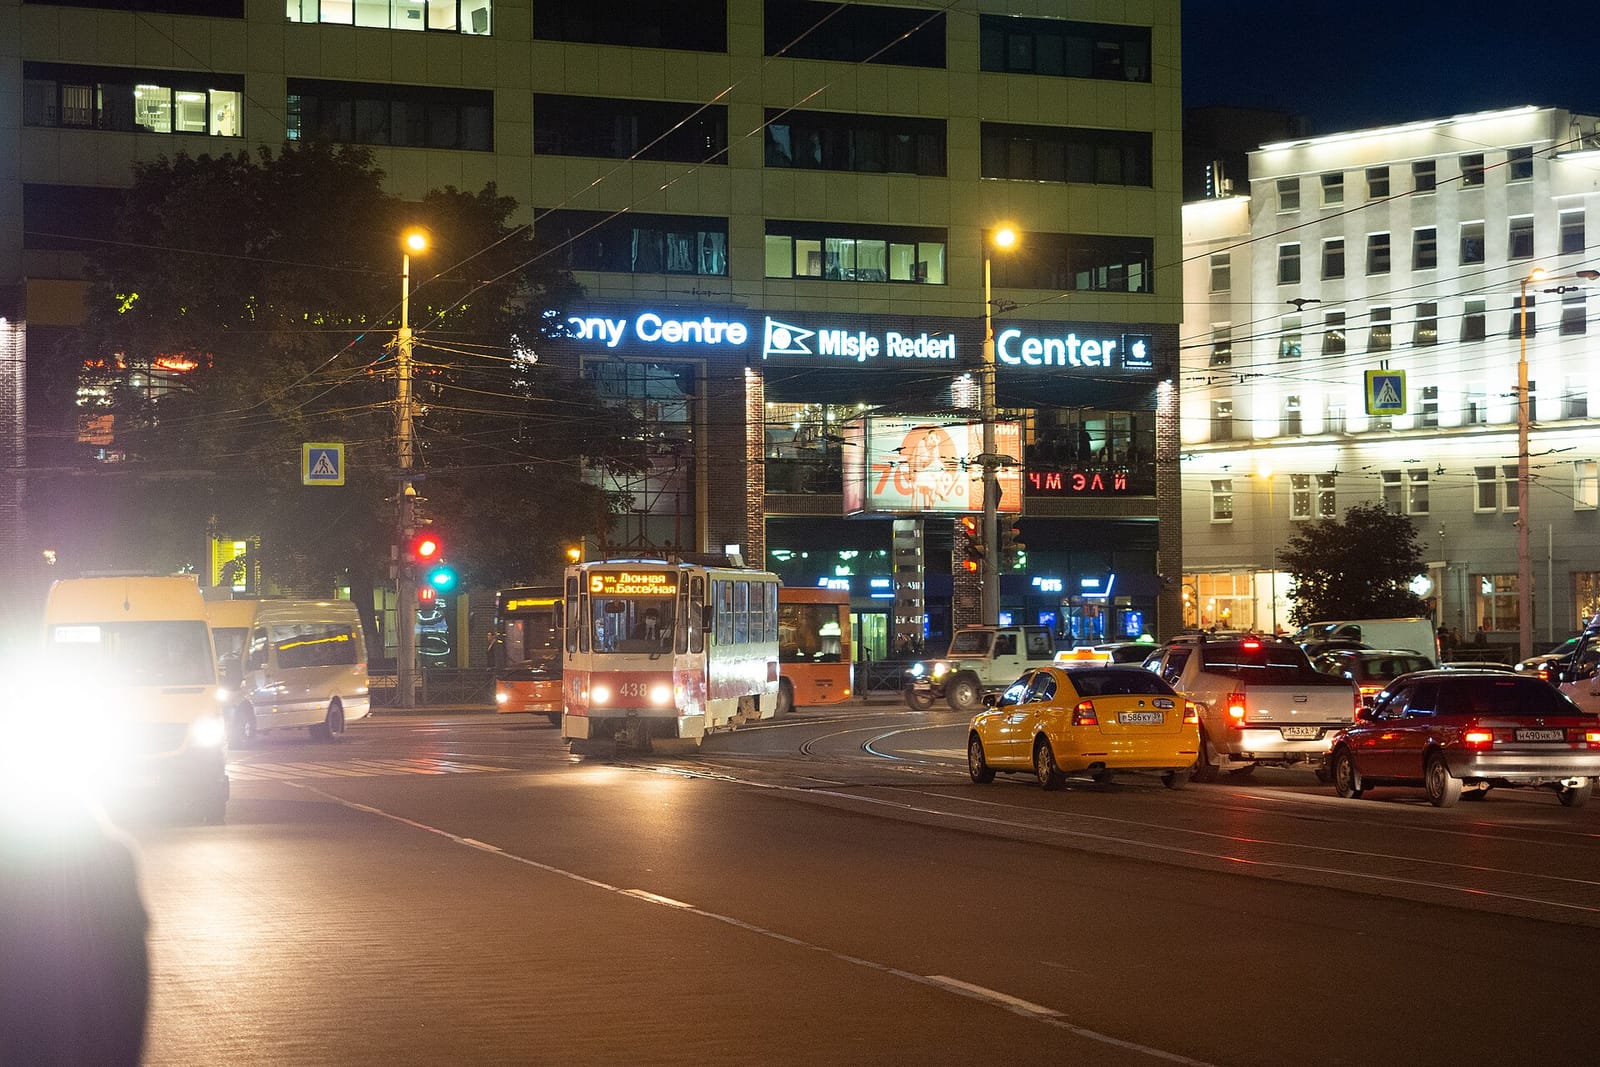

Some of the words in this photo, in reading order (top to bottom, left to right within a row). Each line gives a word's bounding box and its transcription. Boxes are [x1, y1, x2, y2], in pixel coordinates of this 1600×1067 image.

[635, 312, 748, 345] Centre
[818, 329, 880, 362] Misje
[886, 331, 956, 359] Rederi
[997, 329, 1117, 367] Center
[591, 575, 603, 592] 5
[619, 572, 666, 583] Дюнная
[619, 682, 648, 697] 438
